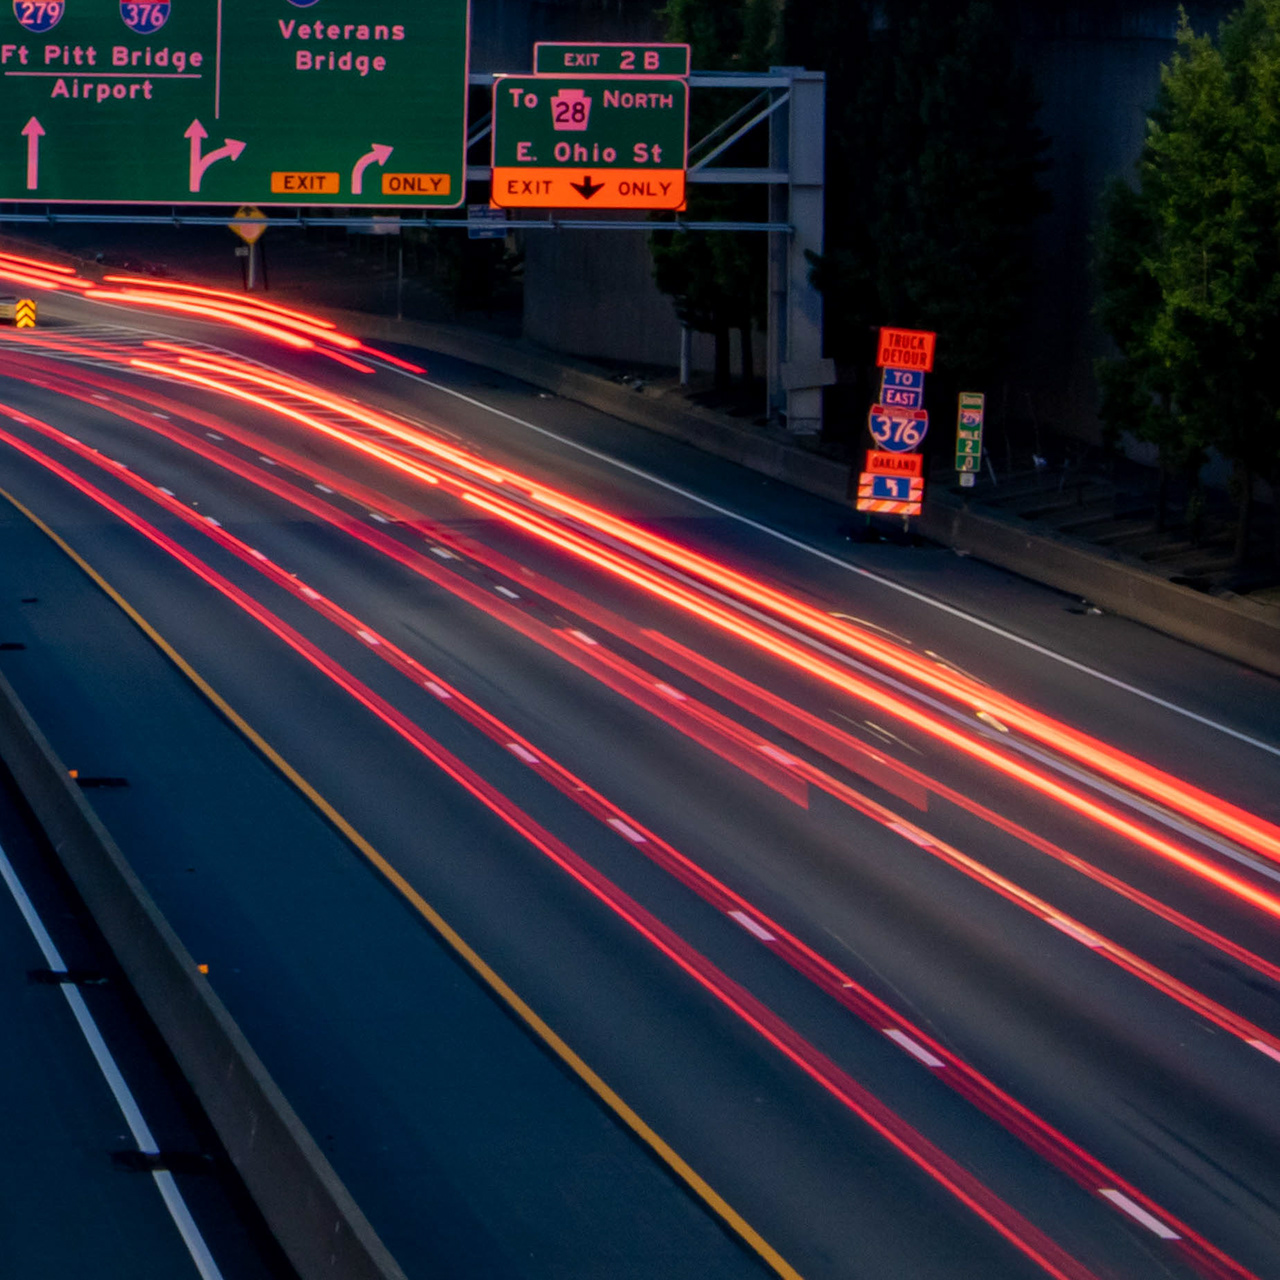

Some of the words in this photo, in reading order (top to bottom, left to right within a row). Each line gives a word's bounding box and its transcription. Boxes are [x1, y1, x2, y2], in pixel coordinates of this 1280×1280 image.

[21, 3, 59, 25] 279
[126, 5, 164, 26] 376
[279, 20, 406, 41] Veterans
[1, 46, 30, 65] Ft
[44, 46, 97, 65] Pitt
[112, 46, 203, 73] Bridge
[296, 50, 387, 77] Bridge
[564, 53, 600, 66] EXIT
[51, 79, 154, 103] Airport
[555, 102, 585, 123] 28
[603, 90, 673, 108] NORTH
[516, 142, 537, 161] E.
[554, 142, 616, 162] Ohio
[633, 143, 662, 163] St
[283, 176, 327, 191] EXIT
[389, 176, 443, 192] ONLY
[508, 180, 553, 195] EXIT
[618, 182, 672, 196] ONLY
[888, 333, 925, 350] TRUCK
[882, 348, 927, 366] DETOUR
[894, 372, 913, 385] TO
[886, 390, 915, 405] EAST
[874, 415, 920, 445] 376
[965, 441, 973, 452] 2
[872, 457, 916, 472] OAKLAND
